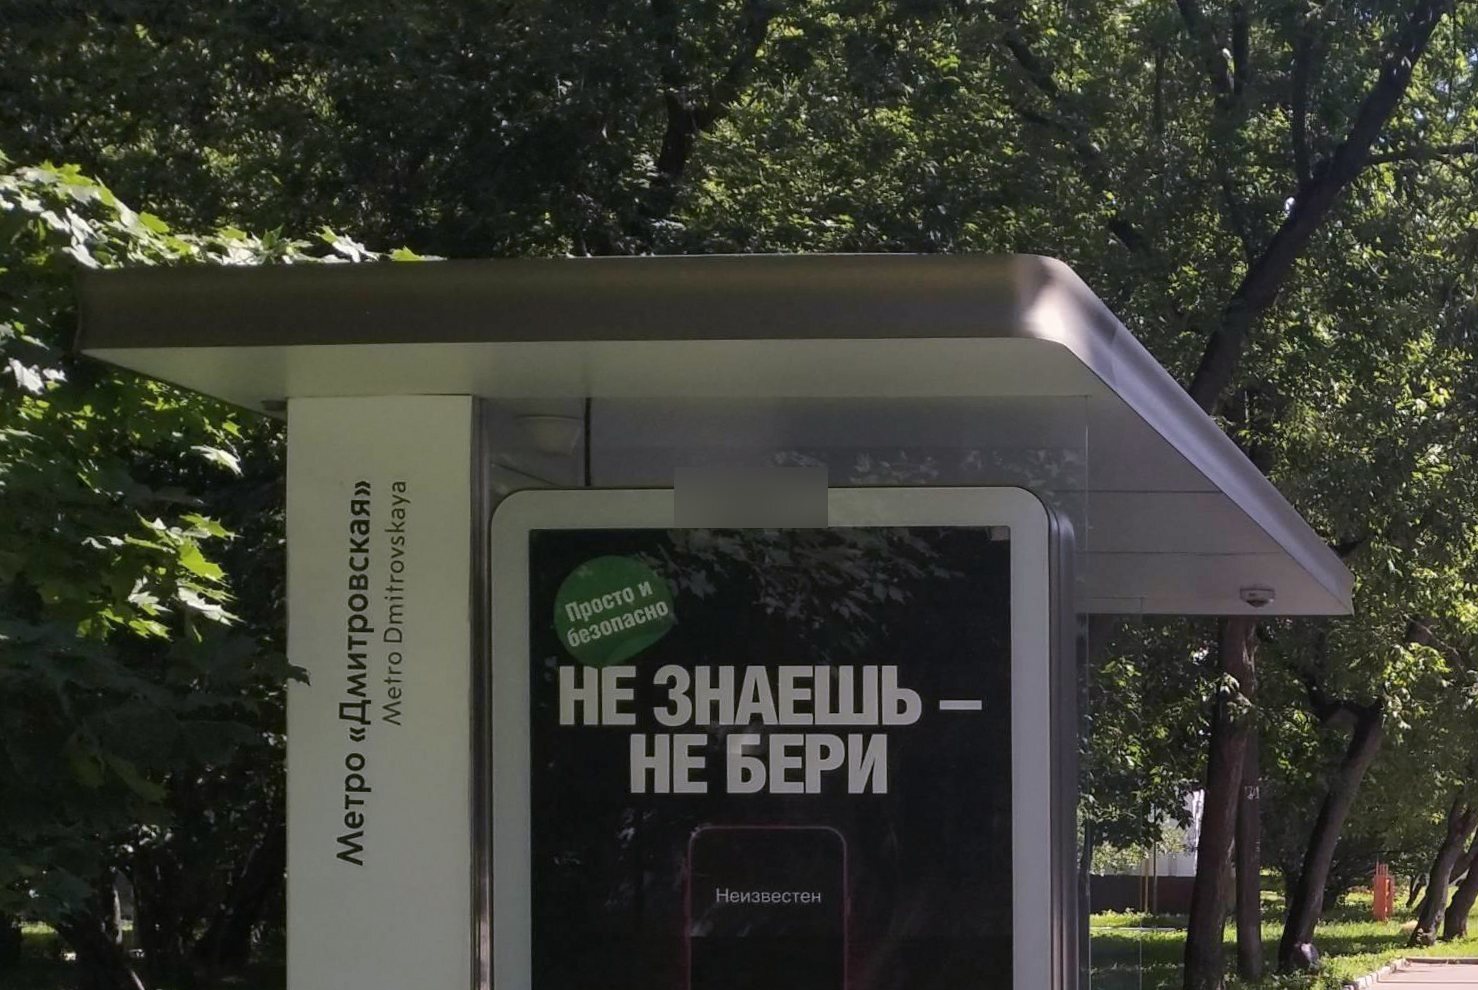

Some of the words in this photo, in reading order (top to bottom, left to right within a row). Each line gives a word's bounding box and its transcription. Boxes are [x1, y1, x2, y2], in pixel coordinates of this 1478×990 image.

[383, 481, 412, 644] Dmitrovskaya
[338, 480, 375, 743] «Дмитровская»
[565, 586, 635, 623] Просто
[638, 581, 654, 598] и
[567, 600, 669, 648] безопасно
[381, 651, 403, 726] Metro
[559, 665, 636, 726] НЕ
[652, 664, 922, 727] ЗНАЕШЬ
[630, 733, 708, 794] НЕ
[726, 733, 888, 795] БЕРИ
[336, 752, 372, 867] Метро
[715, 887, 822, 904] Неизвестен
